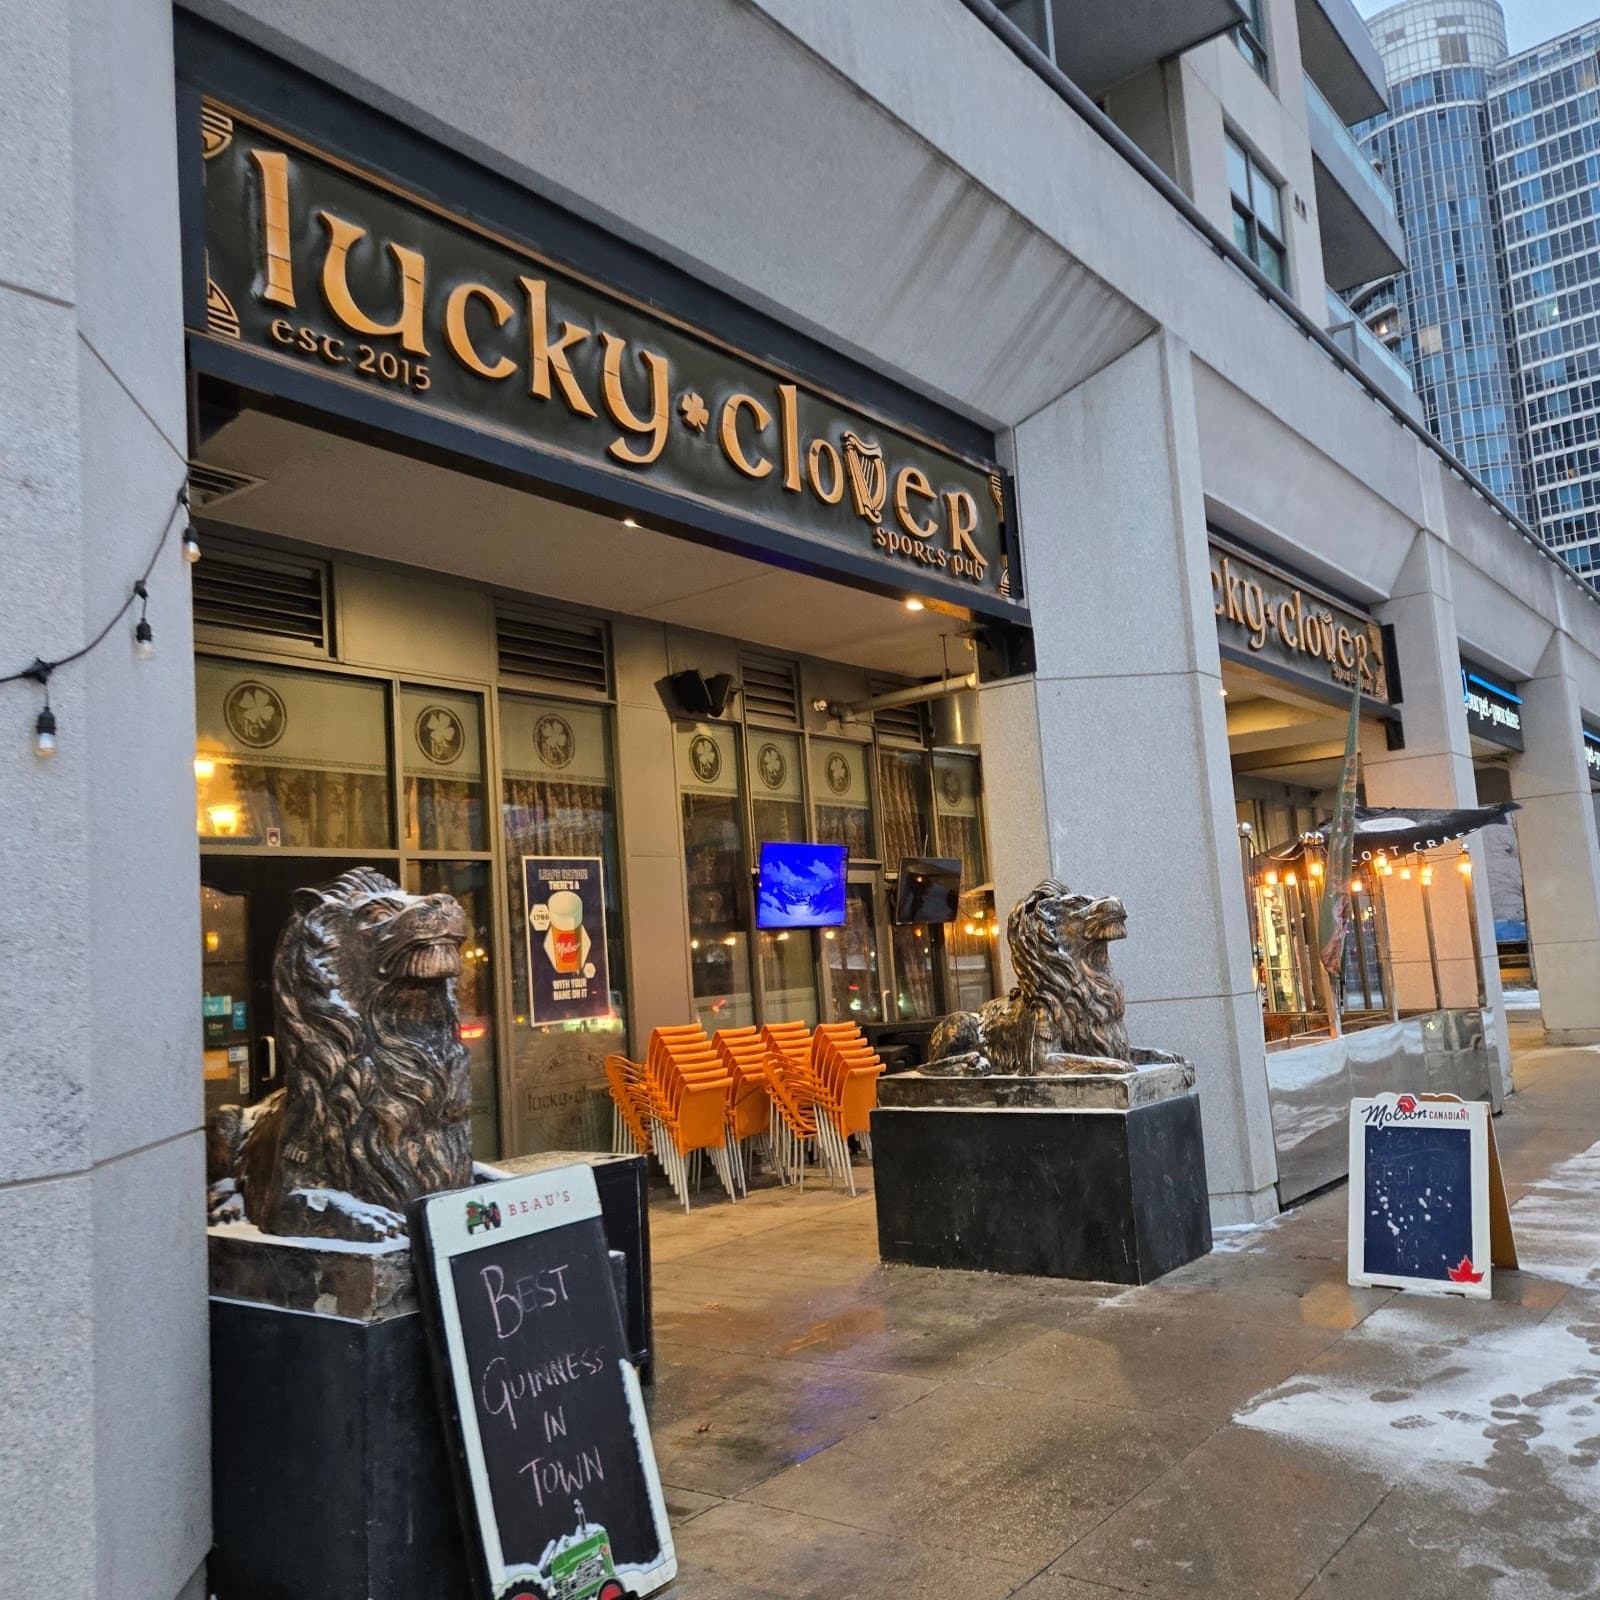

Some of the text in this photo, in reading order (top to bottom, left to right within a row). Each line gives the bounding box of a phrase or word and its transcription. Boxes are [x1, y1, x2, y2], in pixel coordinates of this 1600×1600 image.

[249, 148, 669, 464] lucky
[358, 343, 431, 391] 2015
[950, 553, 986, 582] pub
[552, 978, 587, 990] WITH YOUR
[581, 988, 588, 998] IT
[1361, 1104, 1466, 1128] Molson CANADIAN
[508, 1190, 571, 1217] BEAU'S
[544, 1405, 567, 1443] IN
